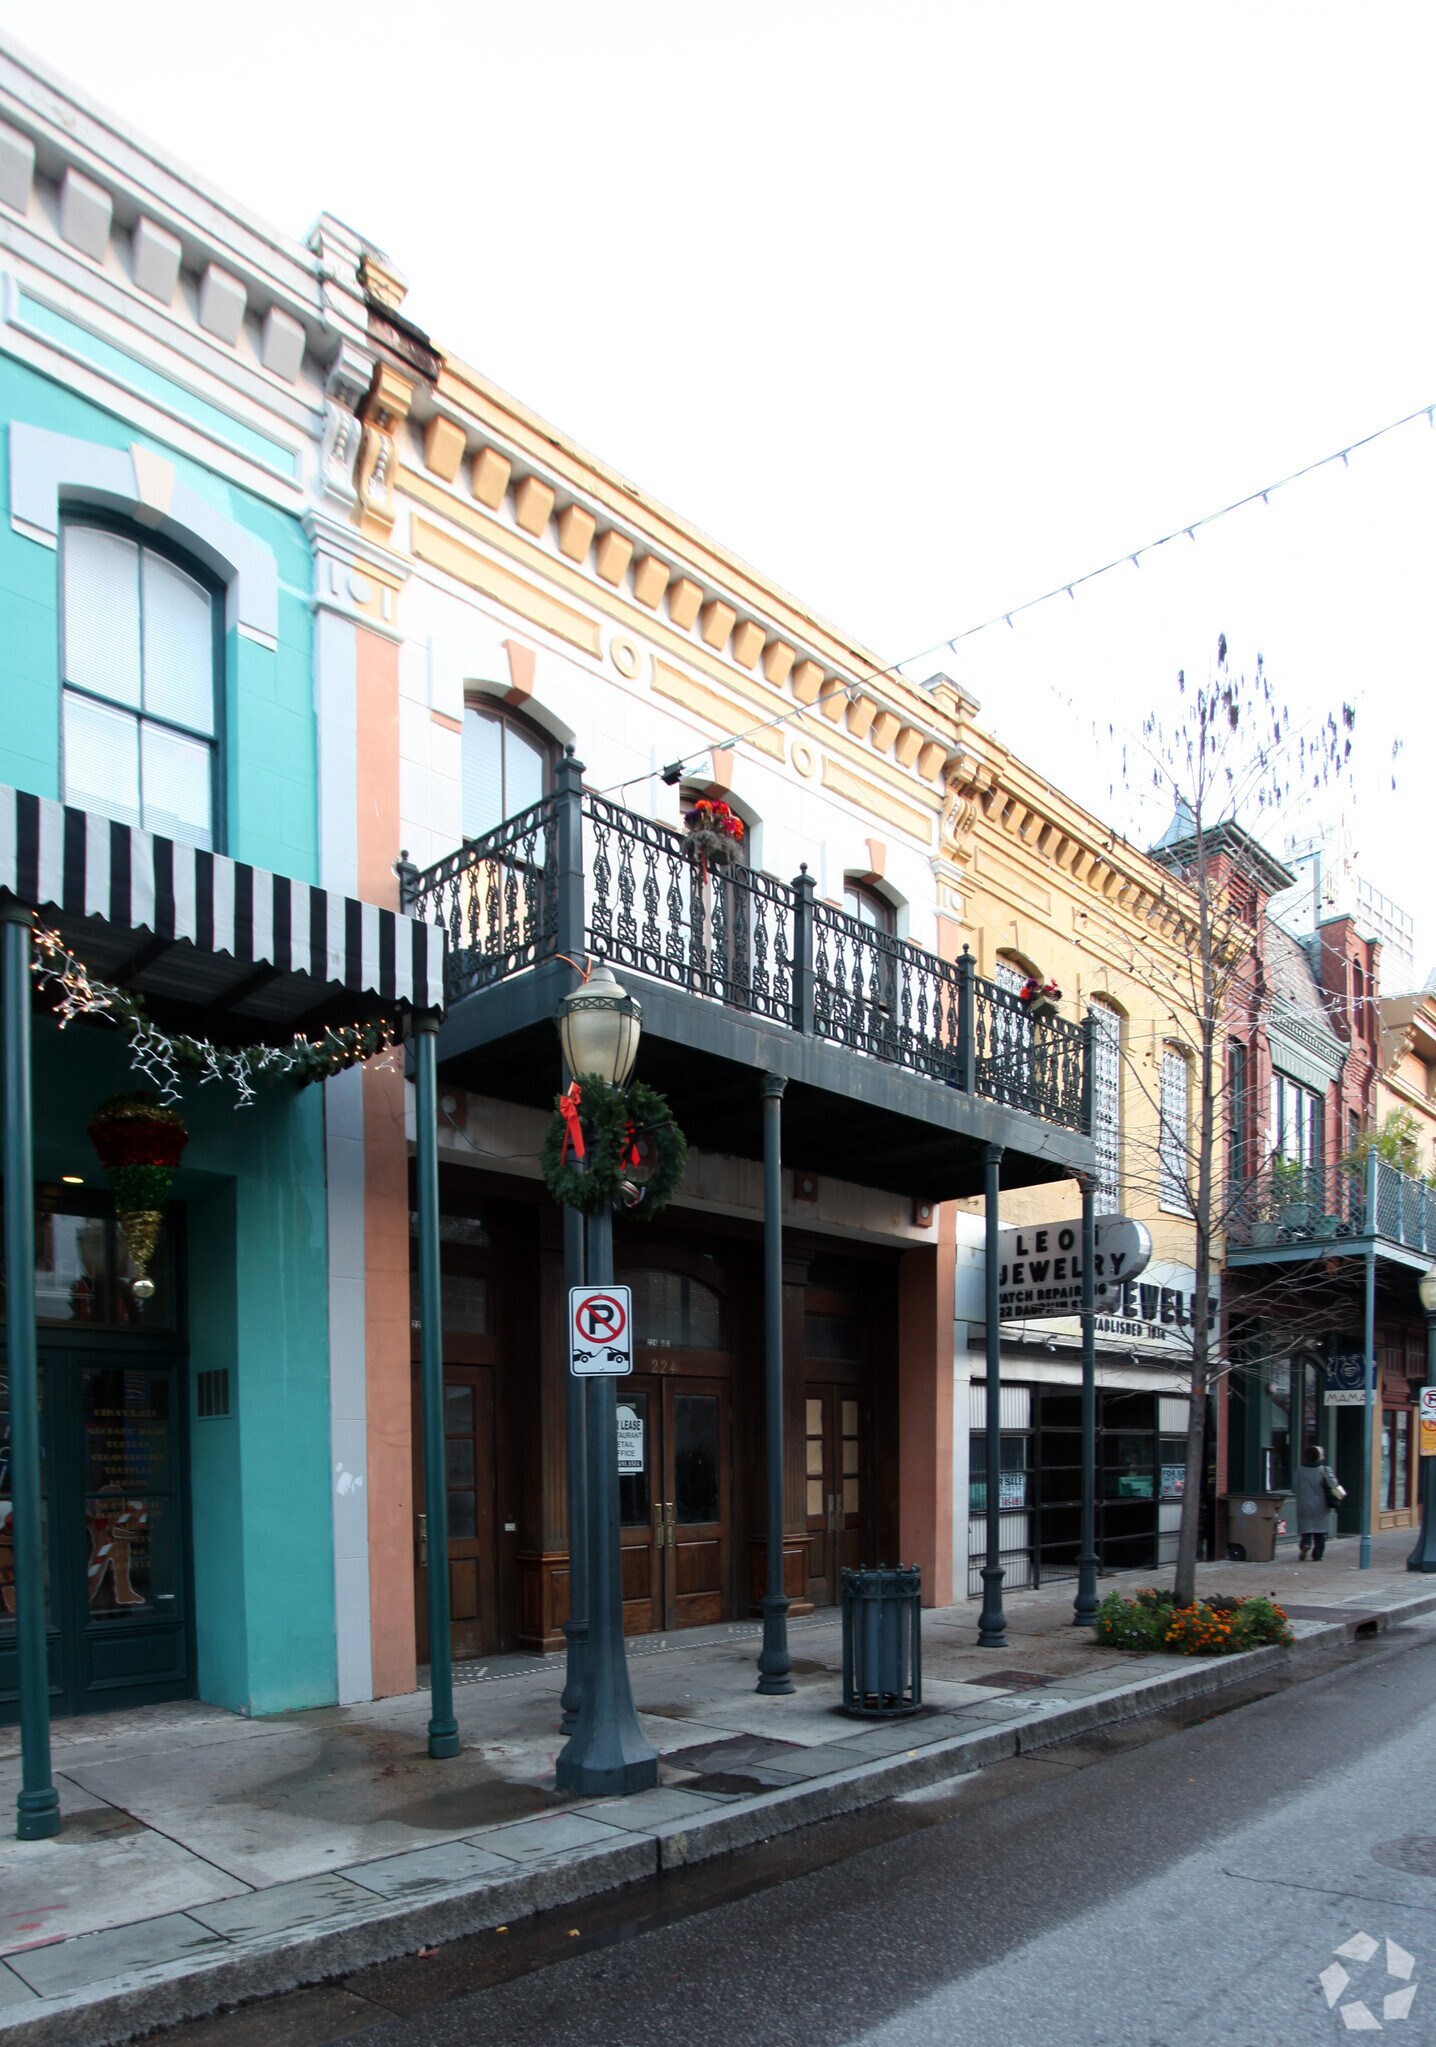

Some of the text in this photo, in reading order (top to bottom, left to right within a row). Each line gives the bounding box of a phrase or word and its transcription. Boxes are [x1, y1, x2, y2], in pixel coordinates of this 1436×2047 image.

[1017, 1224, 1100, 1257] LEO
[1000, 1253, 1126, 1286] JEWELRY
[1000, 1283, 1107, 1304] ATCH REPAIRG
[1123, 1281, 1219, 1330] EWELY
[651, 1359, 677, 1374] 224
[1326, 1393, 1374, 1403] MAMA
[621, 1420, 641, 1430] LEASE
[1005, 1477, 1023, 1485] SALE
